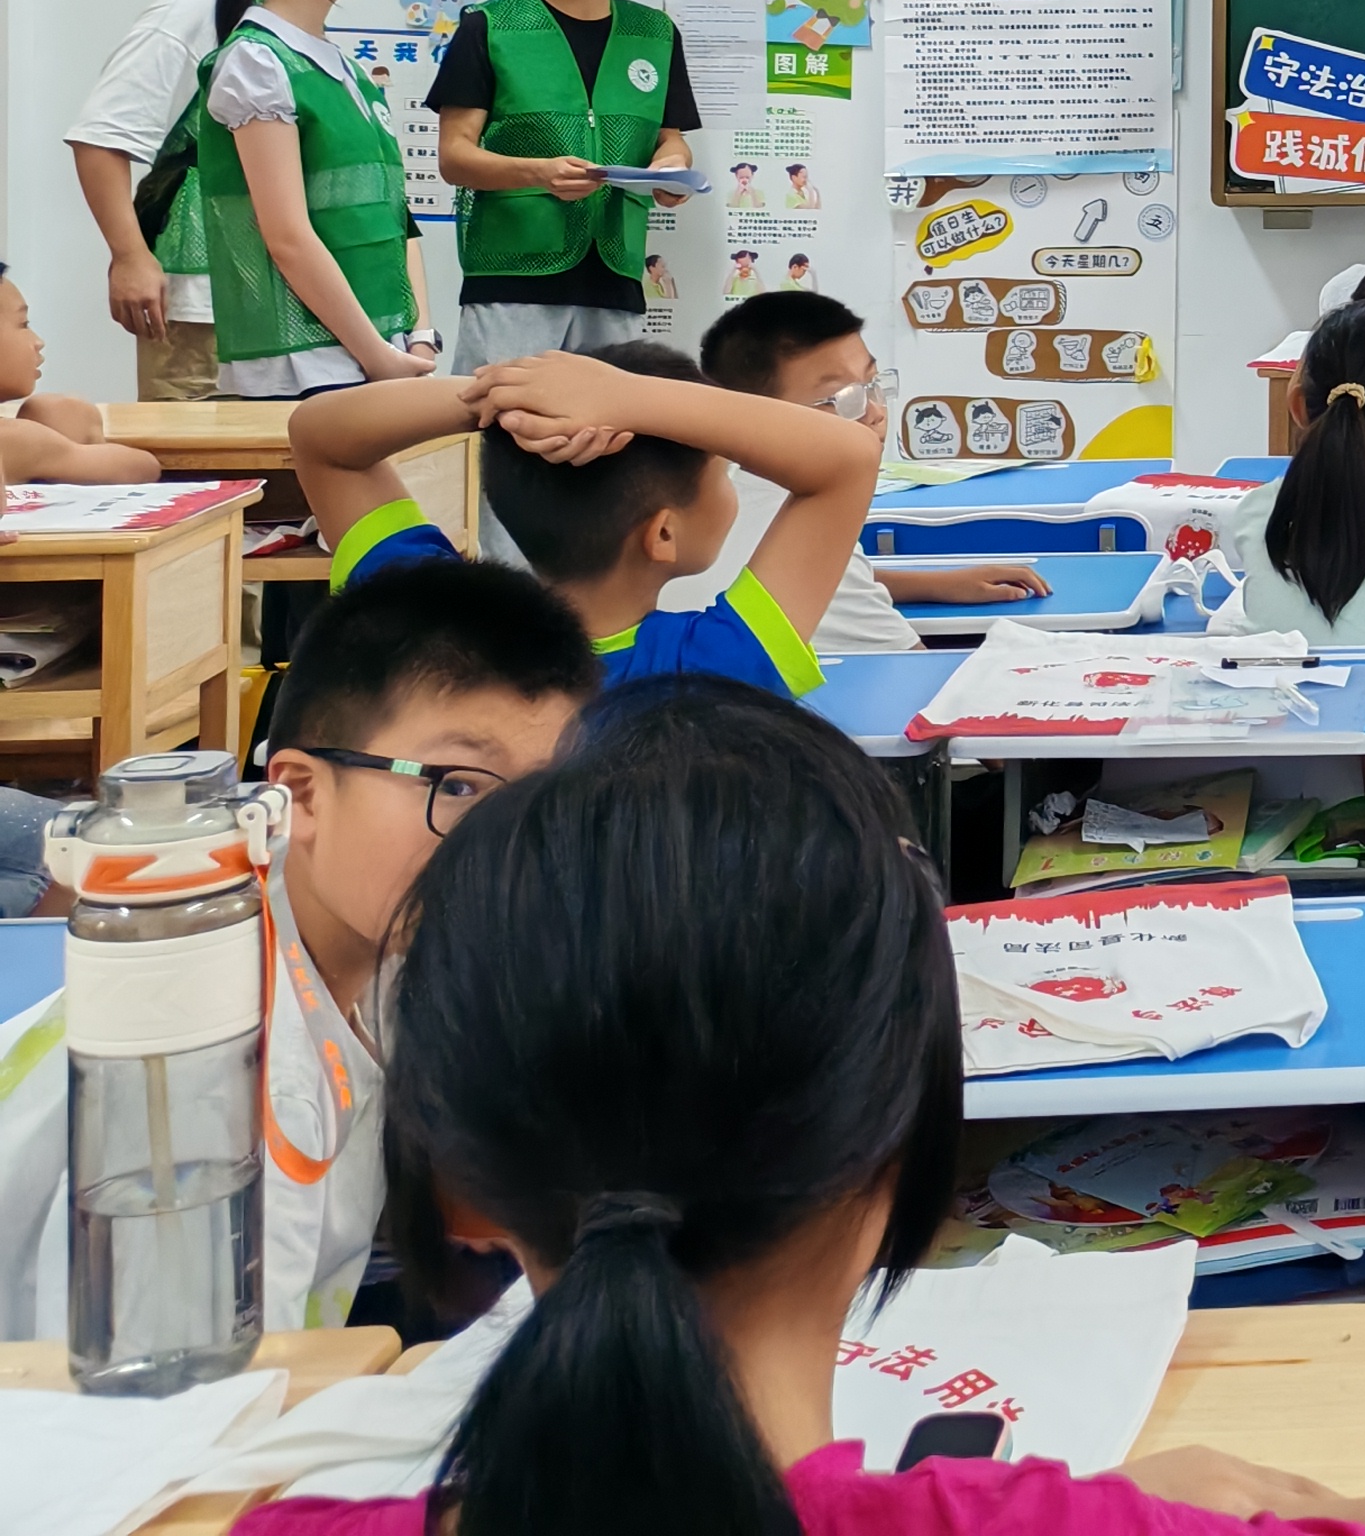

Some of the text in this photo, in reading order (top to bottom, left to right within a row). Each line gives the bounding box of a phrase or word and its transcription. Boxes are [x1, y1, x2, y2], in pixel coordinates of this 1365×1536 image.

[773, 52, 830, 77] 图解
[930, 210, 979, 238] 值日生
[1145, 214, 1164, 232] 五
[1003, 931, 1188, 954] 新化县司法局
